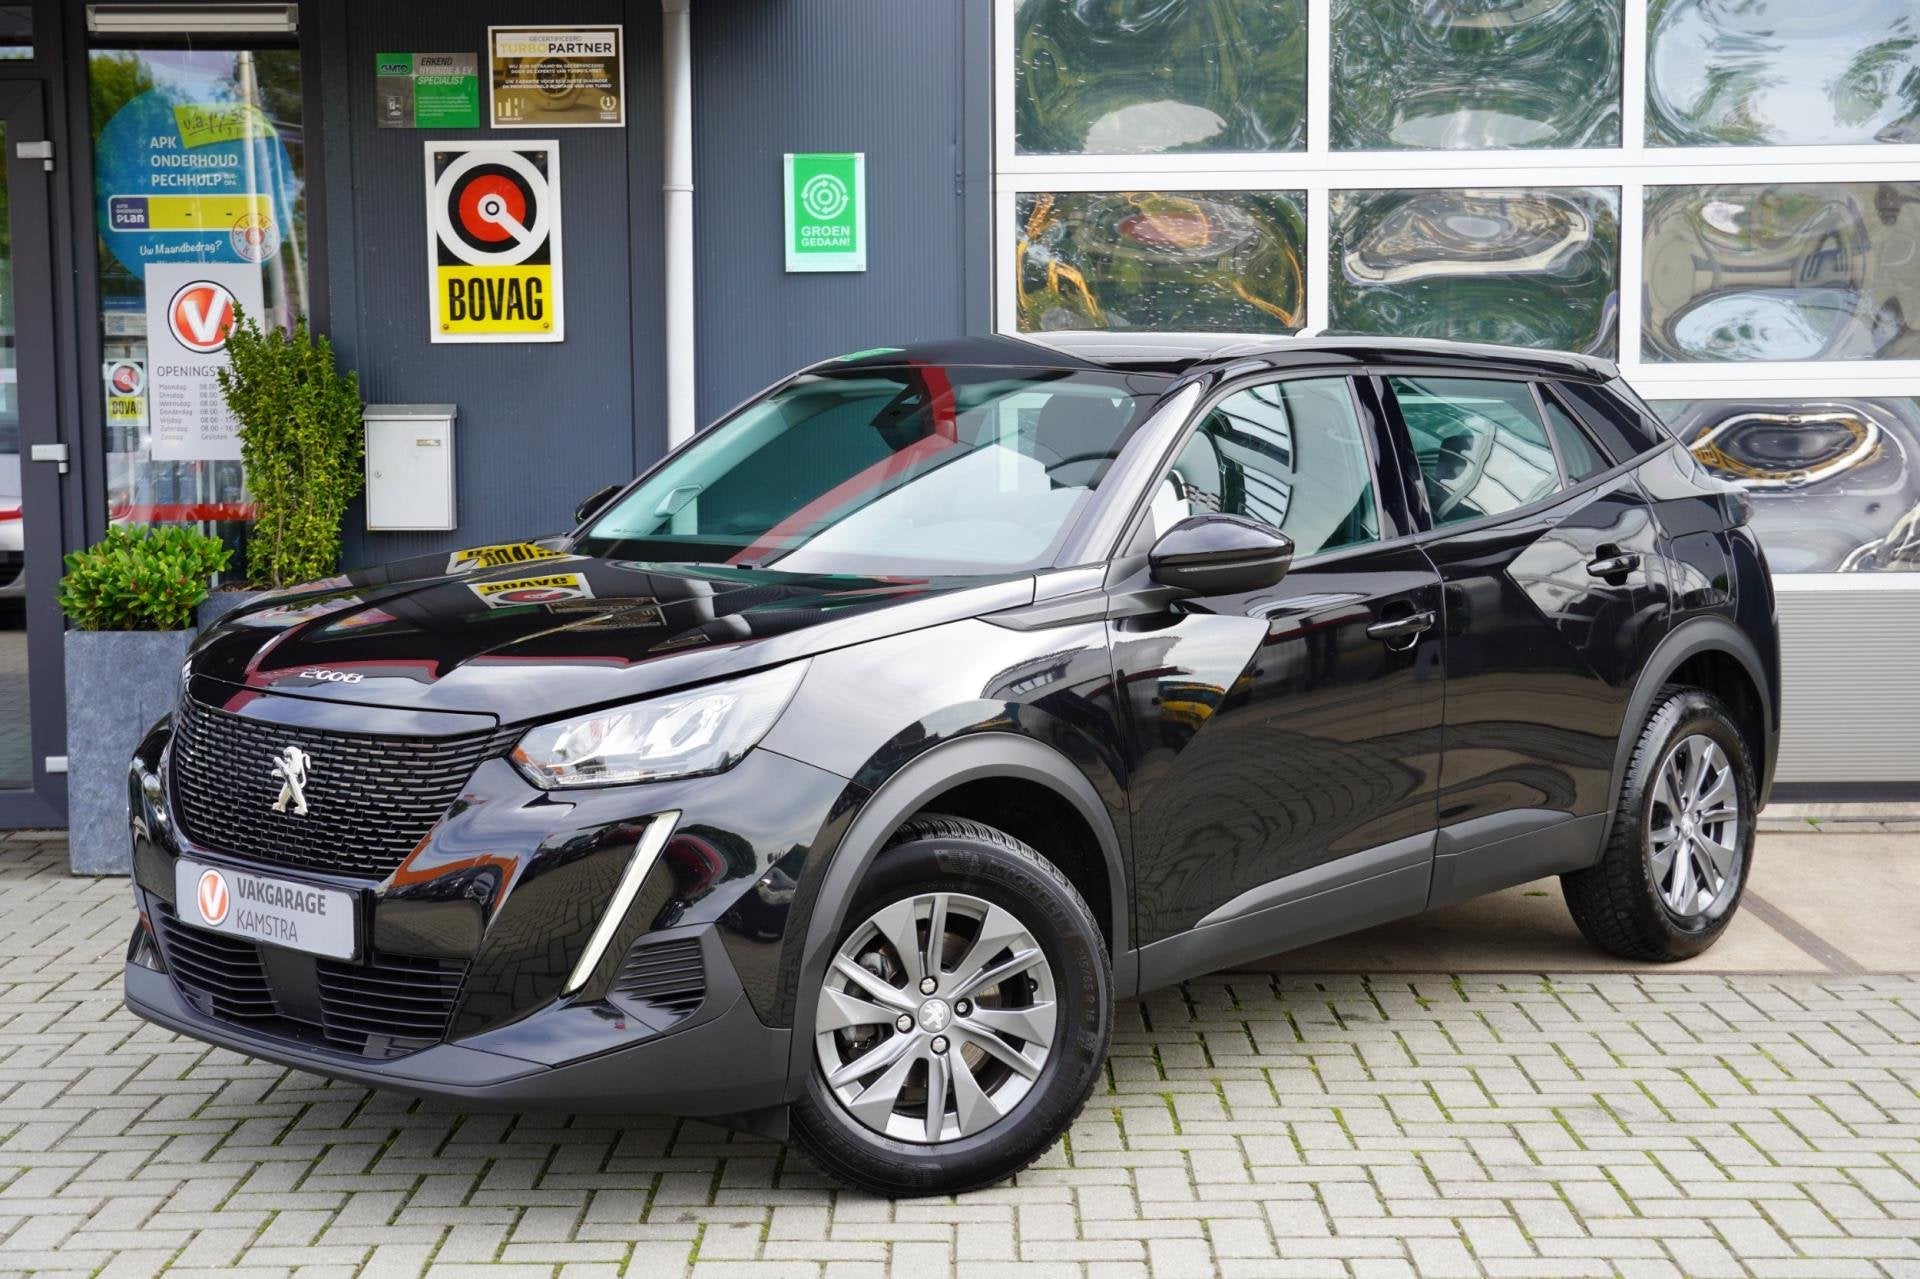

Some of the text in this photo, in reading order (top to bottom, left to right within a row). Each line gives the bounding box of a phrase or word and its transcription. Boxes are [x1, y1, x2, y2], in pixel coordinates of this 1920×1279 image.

[501, 43, 612, 54] TURBOPARTNER
[421, 57, 453, 66] ERKEND
[418, 76, 464, 85] SPECIALIST
[150, 136, 177, 149] APK
[151, 154, 238, 167] ONDERHOUD
[152, 173, 221, 186] PECHHULP
[801, 225, 851, 237] GROEN
[140, 240, 222, 256] Uw Maandbedrag?
[801, 237, 851, 247] GEDAAN!
[447, 277, 543, 322] BOVAG
[112, 401, 143, 415] BOVAG
[300, 669, 364, 684] 2008
[237, 876, 327, 916] VAKGARAGE
[236, 909, 299, 943] KAMSTRA
